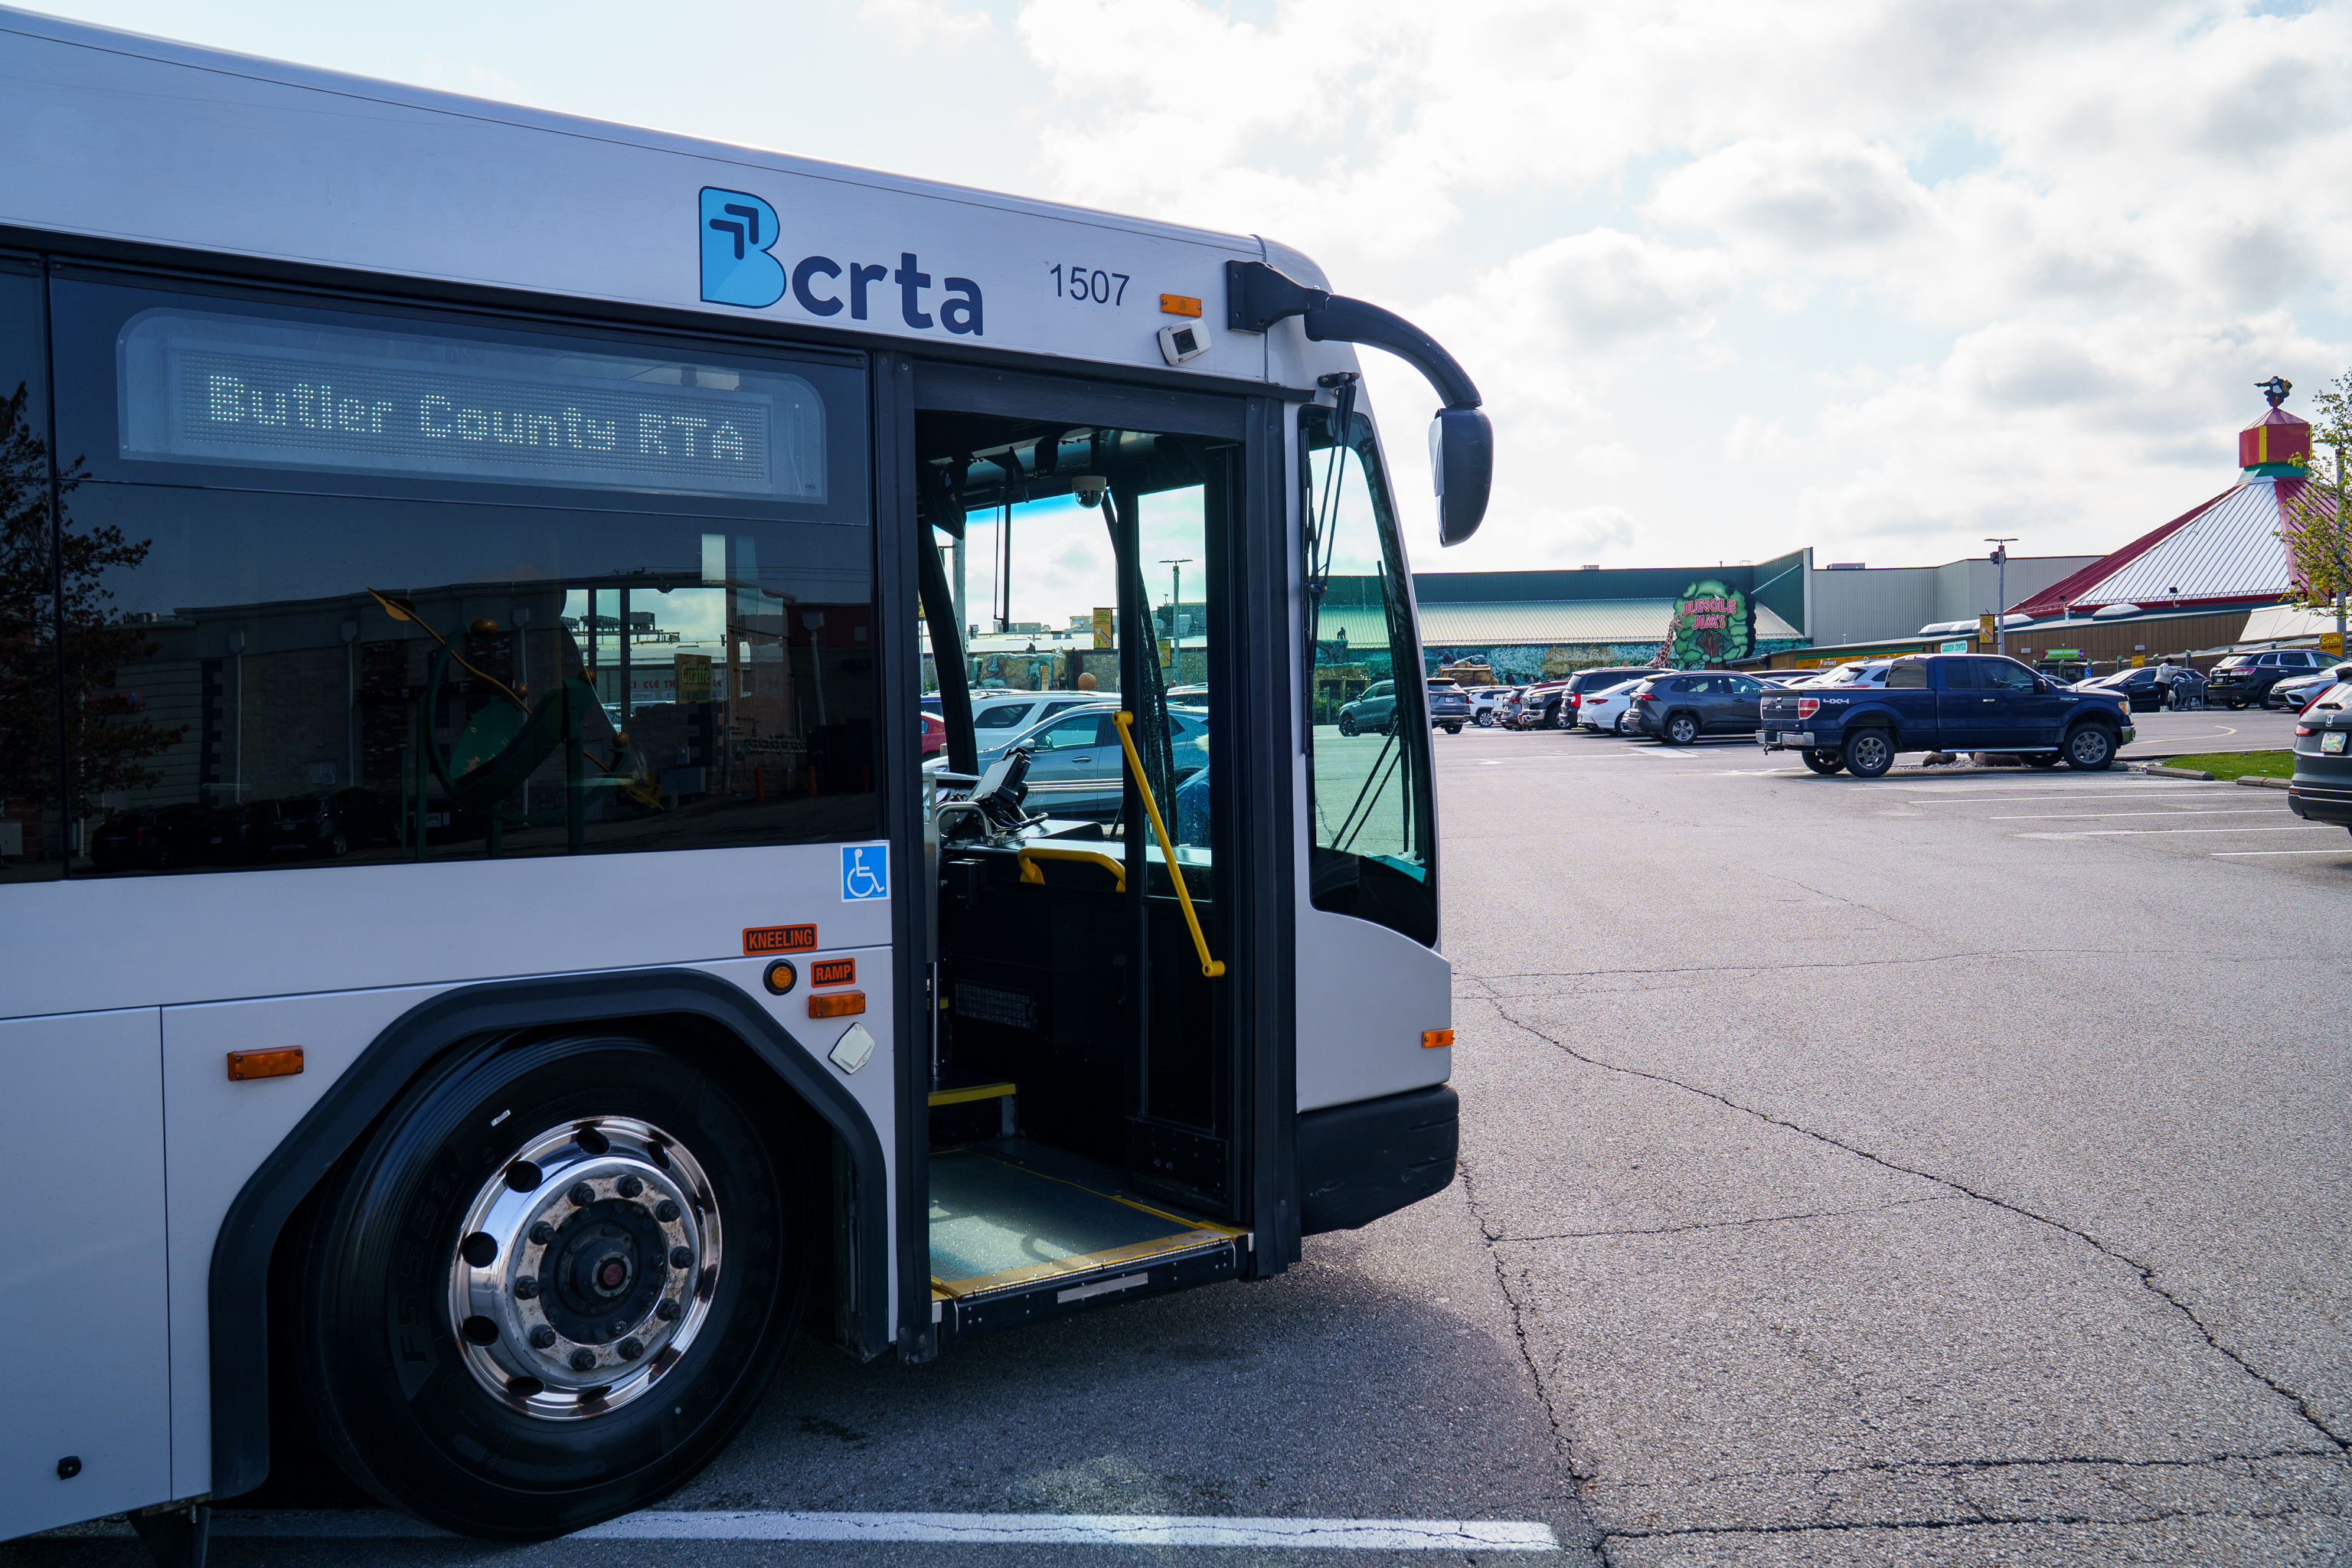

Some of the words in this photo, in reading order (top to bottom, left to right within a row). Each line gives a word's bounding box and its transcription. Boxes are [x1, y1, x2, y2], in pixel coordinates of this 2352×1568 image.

[1049, 263, 1130, 306] 1507
[209, 374, 393, 434] Butler
[421, 394, 616, 451] County
[639, 411, 744, 461] RTA
[1681, 598, 1737, 617] JUNGLE
[1691, 614, 1726, 630] JIM'S
[1942, 644, 1954, 652] GARDEN
[1955, 643, 1966, 652] CENTER
[2321, 636, 2341, 645] Giraffe
[681, 661, 710, 685] Giraffe
[748, 929, 812, 949] KNEELING
[815, 964, 851, 982] RAMP
